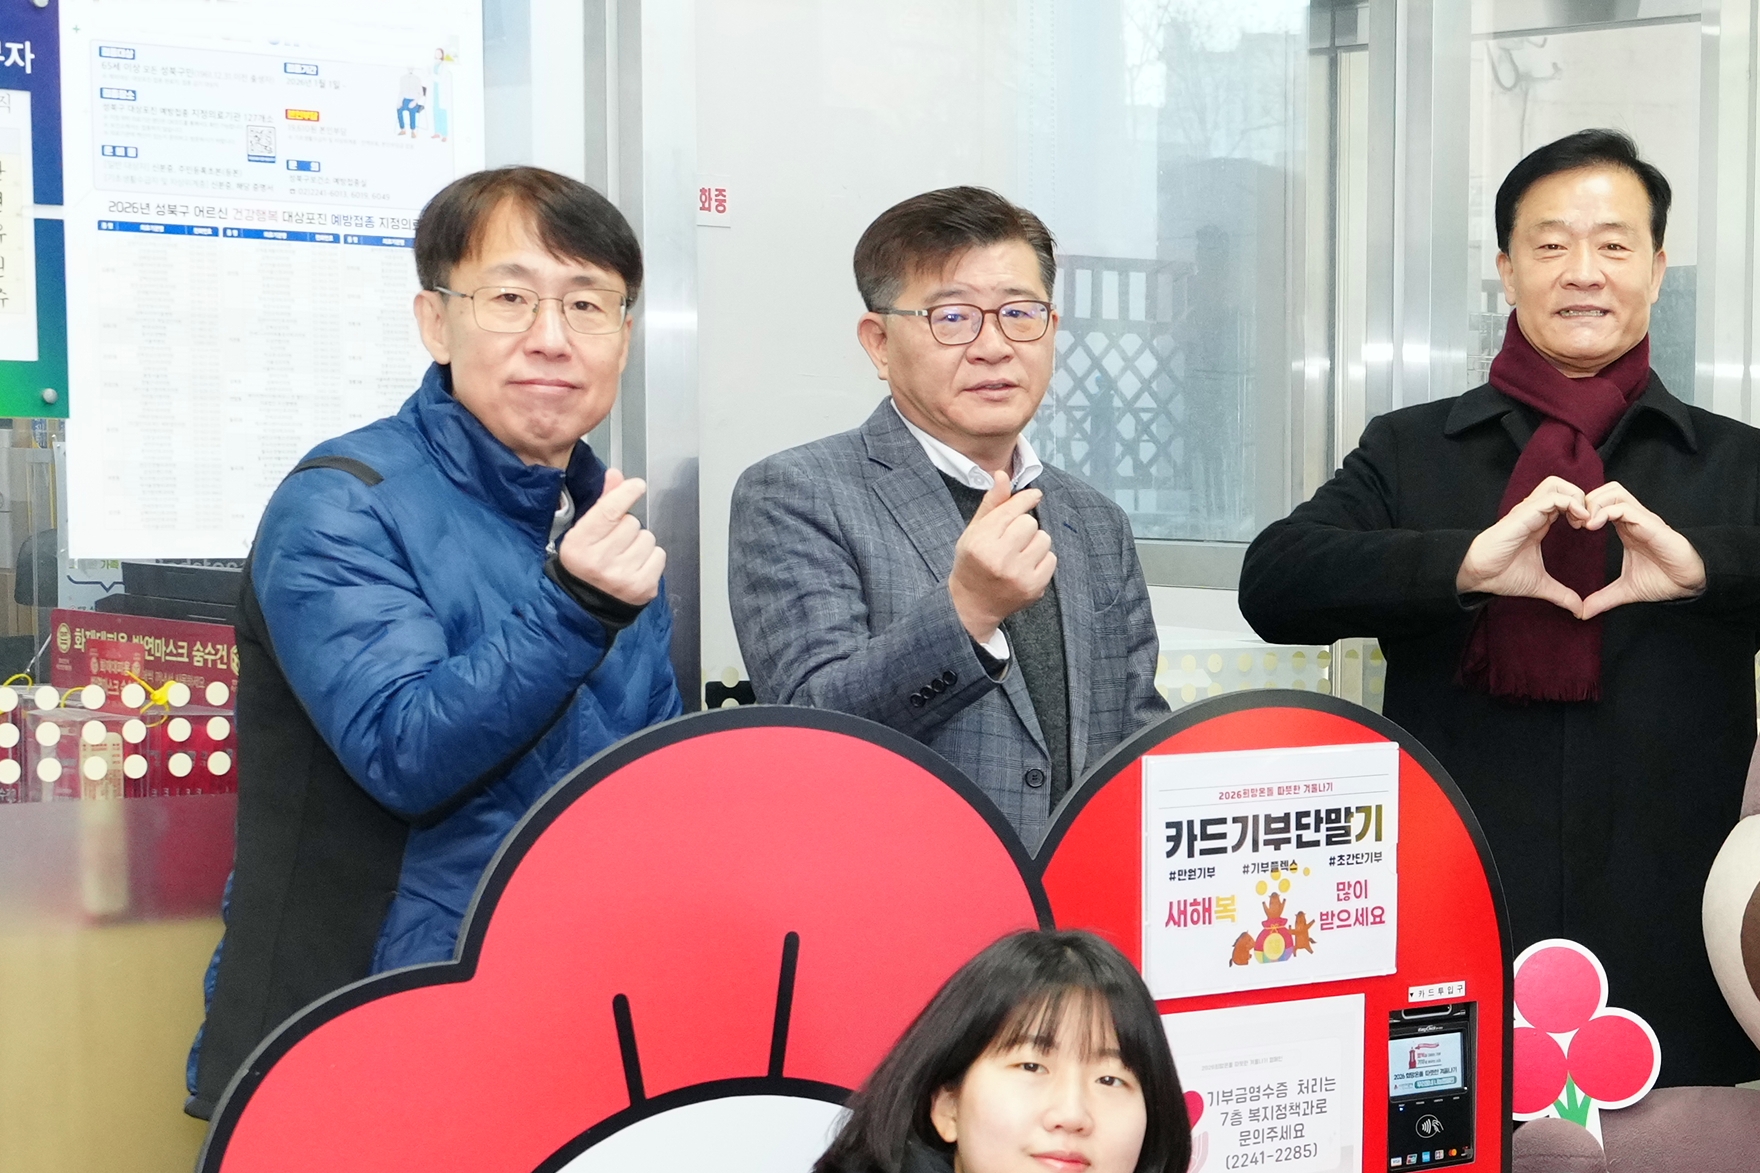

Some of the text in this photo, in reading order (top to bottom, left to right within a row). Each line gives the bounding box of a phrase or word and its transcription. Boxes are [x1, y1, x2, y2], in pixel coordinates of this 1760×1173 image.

[0, 41, 35, 74] 자
[108, 200, 150, 214] 2026년
[156, 203, 189, 216] 성북구
[194, 205, 228, 219] 어르신
[282, 211, 327, 225] 대상포진
[331, 214, 375, 228] 예방접종
[192, 641, 228, 669] 숨수건
[1218, 782, 1334, 800] 2026희망온돌 따뜻한 겨울나기
[1164, 804, 1383, 859] 카드기부단말기
[1168, 851, 1383, 882] #만원기부 #기부플렉스 #초간단기부
[1336, 879, 1368, 902] 많이
[1319, 905, 1386, 931] 받으세요
[1207, 1076, 1337, 1107] 기부금영수증 처리는
[1220, 1098, 1328, 1127] 7층 복지정책과로
[1238, 1122, 1306, 1148] 문의주세요
[1225, 1142, 1319, 1170] (2241-2285)
